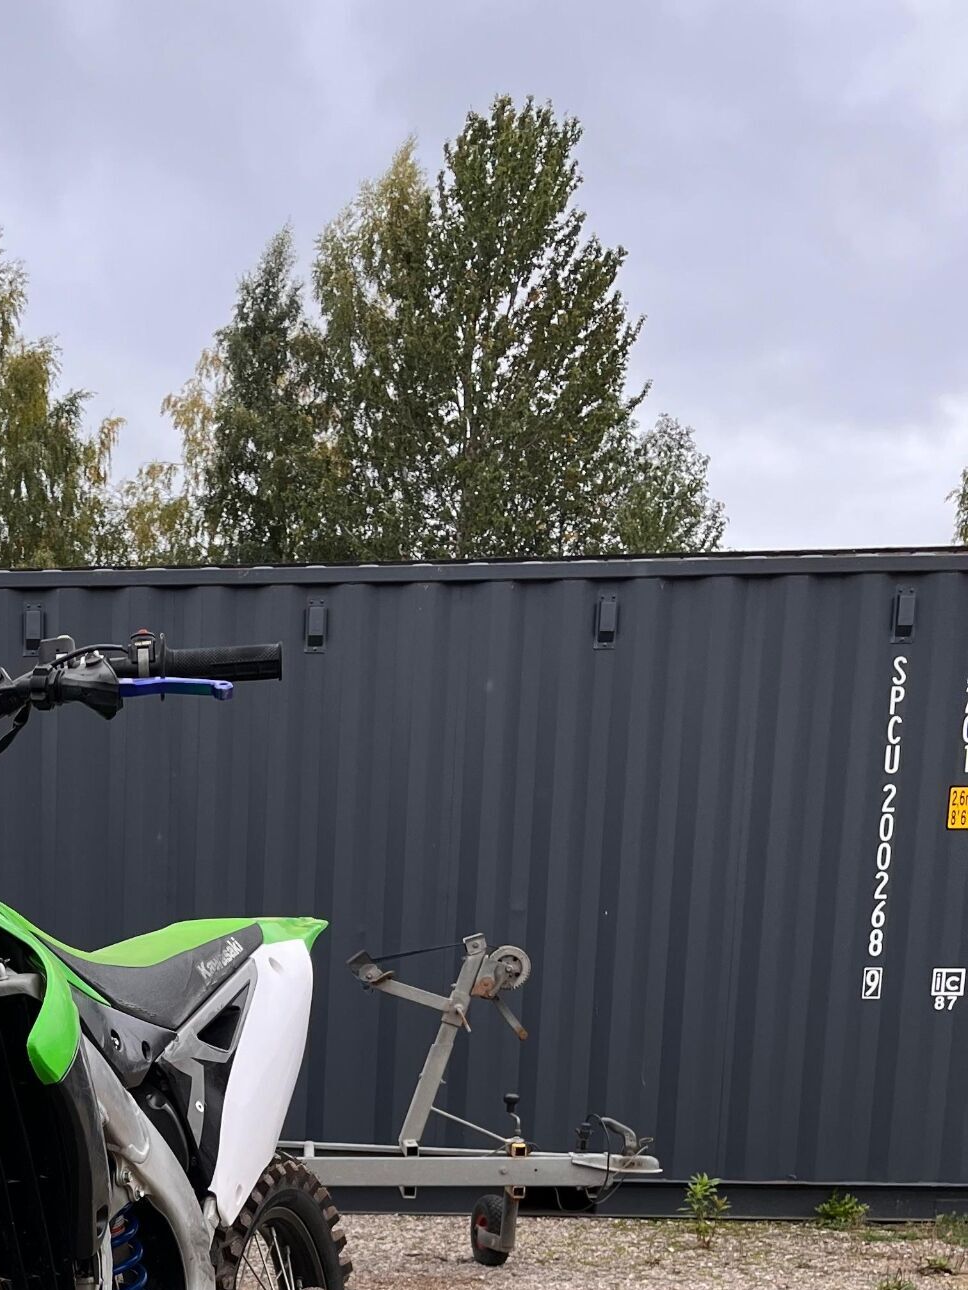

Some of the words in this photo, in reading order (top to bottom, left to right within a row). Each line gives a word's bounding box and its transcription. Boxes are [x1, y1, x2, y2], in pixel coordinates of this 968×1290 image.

[883, 655, 908, 775] SPCU
[867, 782, 898, 957] 200268
[195, 936, 244, 980] Kawasaki
[864, 969, 881, 997] 9
[934, 995, 958, 1011] 87
